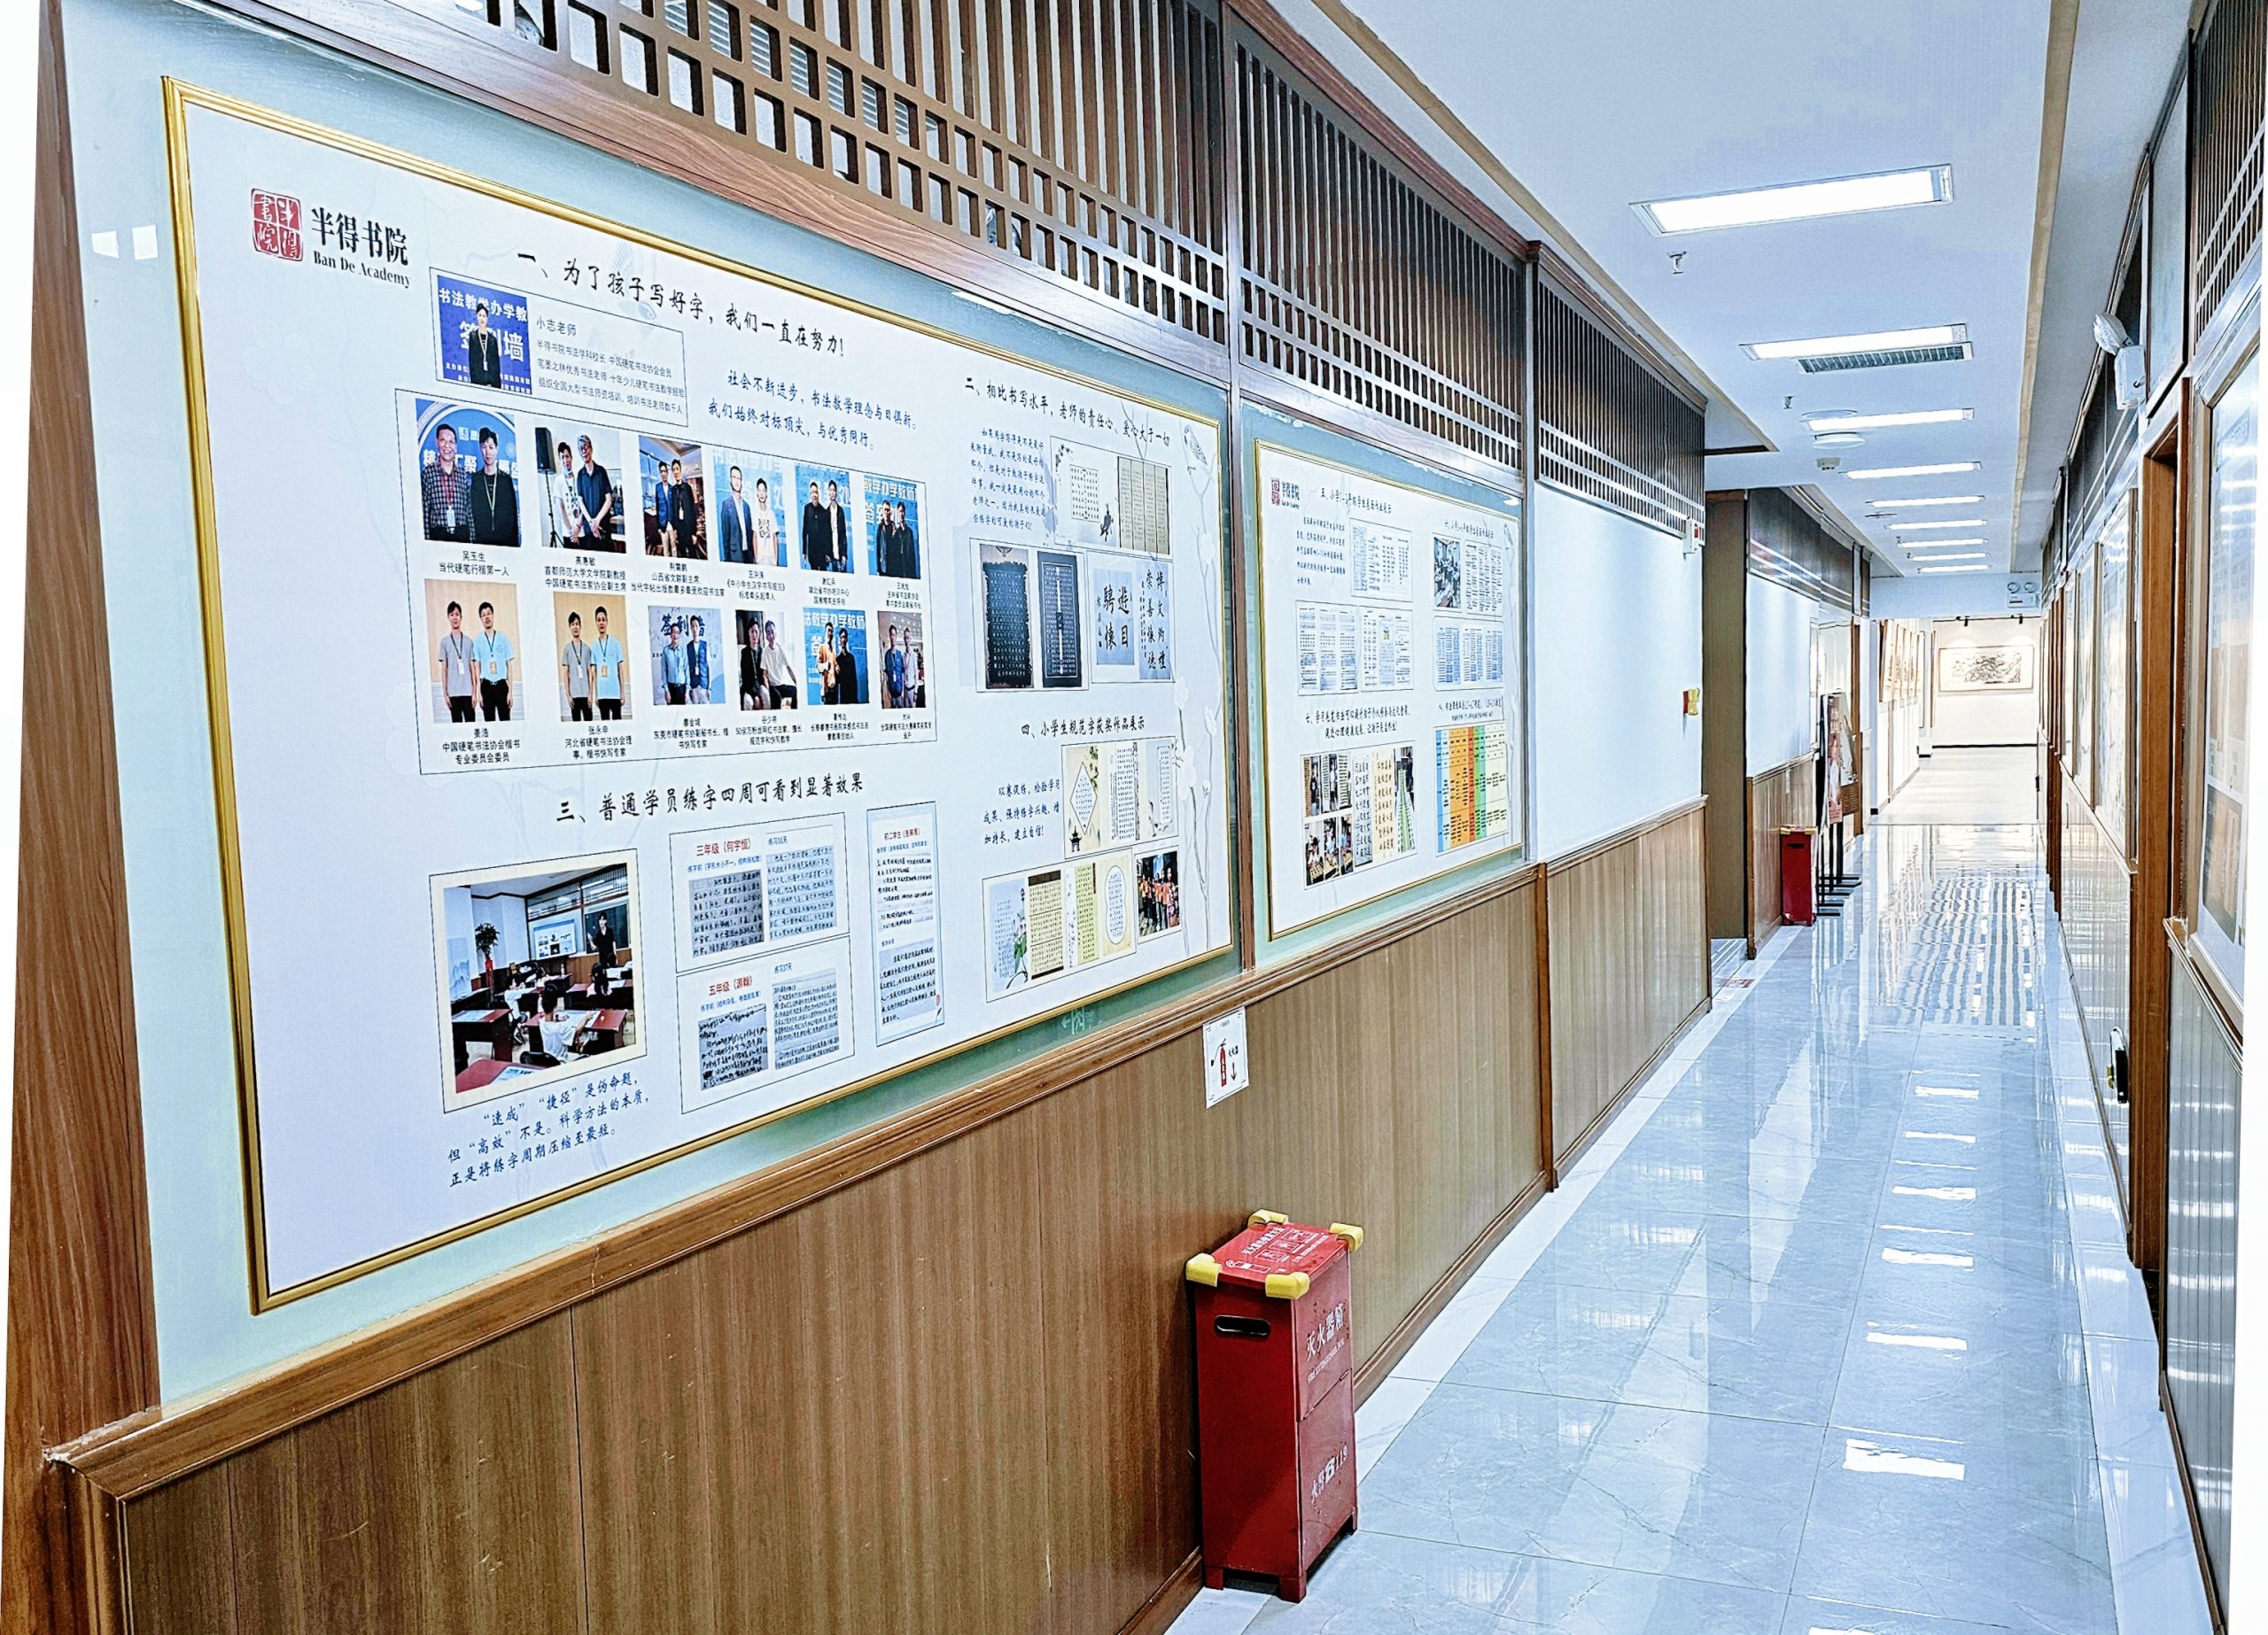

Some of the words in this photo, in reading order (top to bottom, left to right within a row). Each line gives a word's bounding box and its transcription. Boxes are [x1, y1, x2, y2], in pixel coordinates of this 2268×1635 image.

[311, 207, 408, 266] 半得书院
[314, 251, 336, 268] Ban
[340, 257, 355, 273] De
[359, 263, 412, 289] Academy
[536, 315, 577, 337] 小志老师
[1021, 716, 1145, 739] 四、小学生规范字获奖作品展示
[555, 771, 864, 823] 三、普通学员练字四周可看到显著效果
[1307, 1303, 1344, 1361] 灭火器箱
[1335, 1445, 1348, 1471] 119
